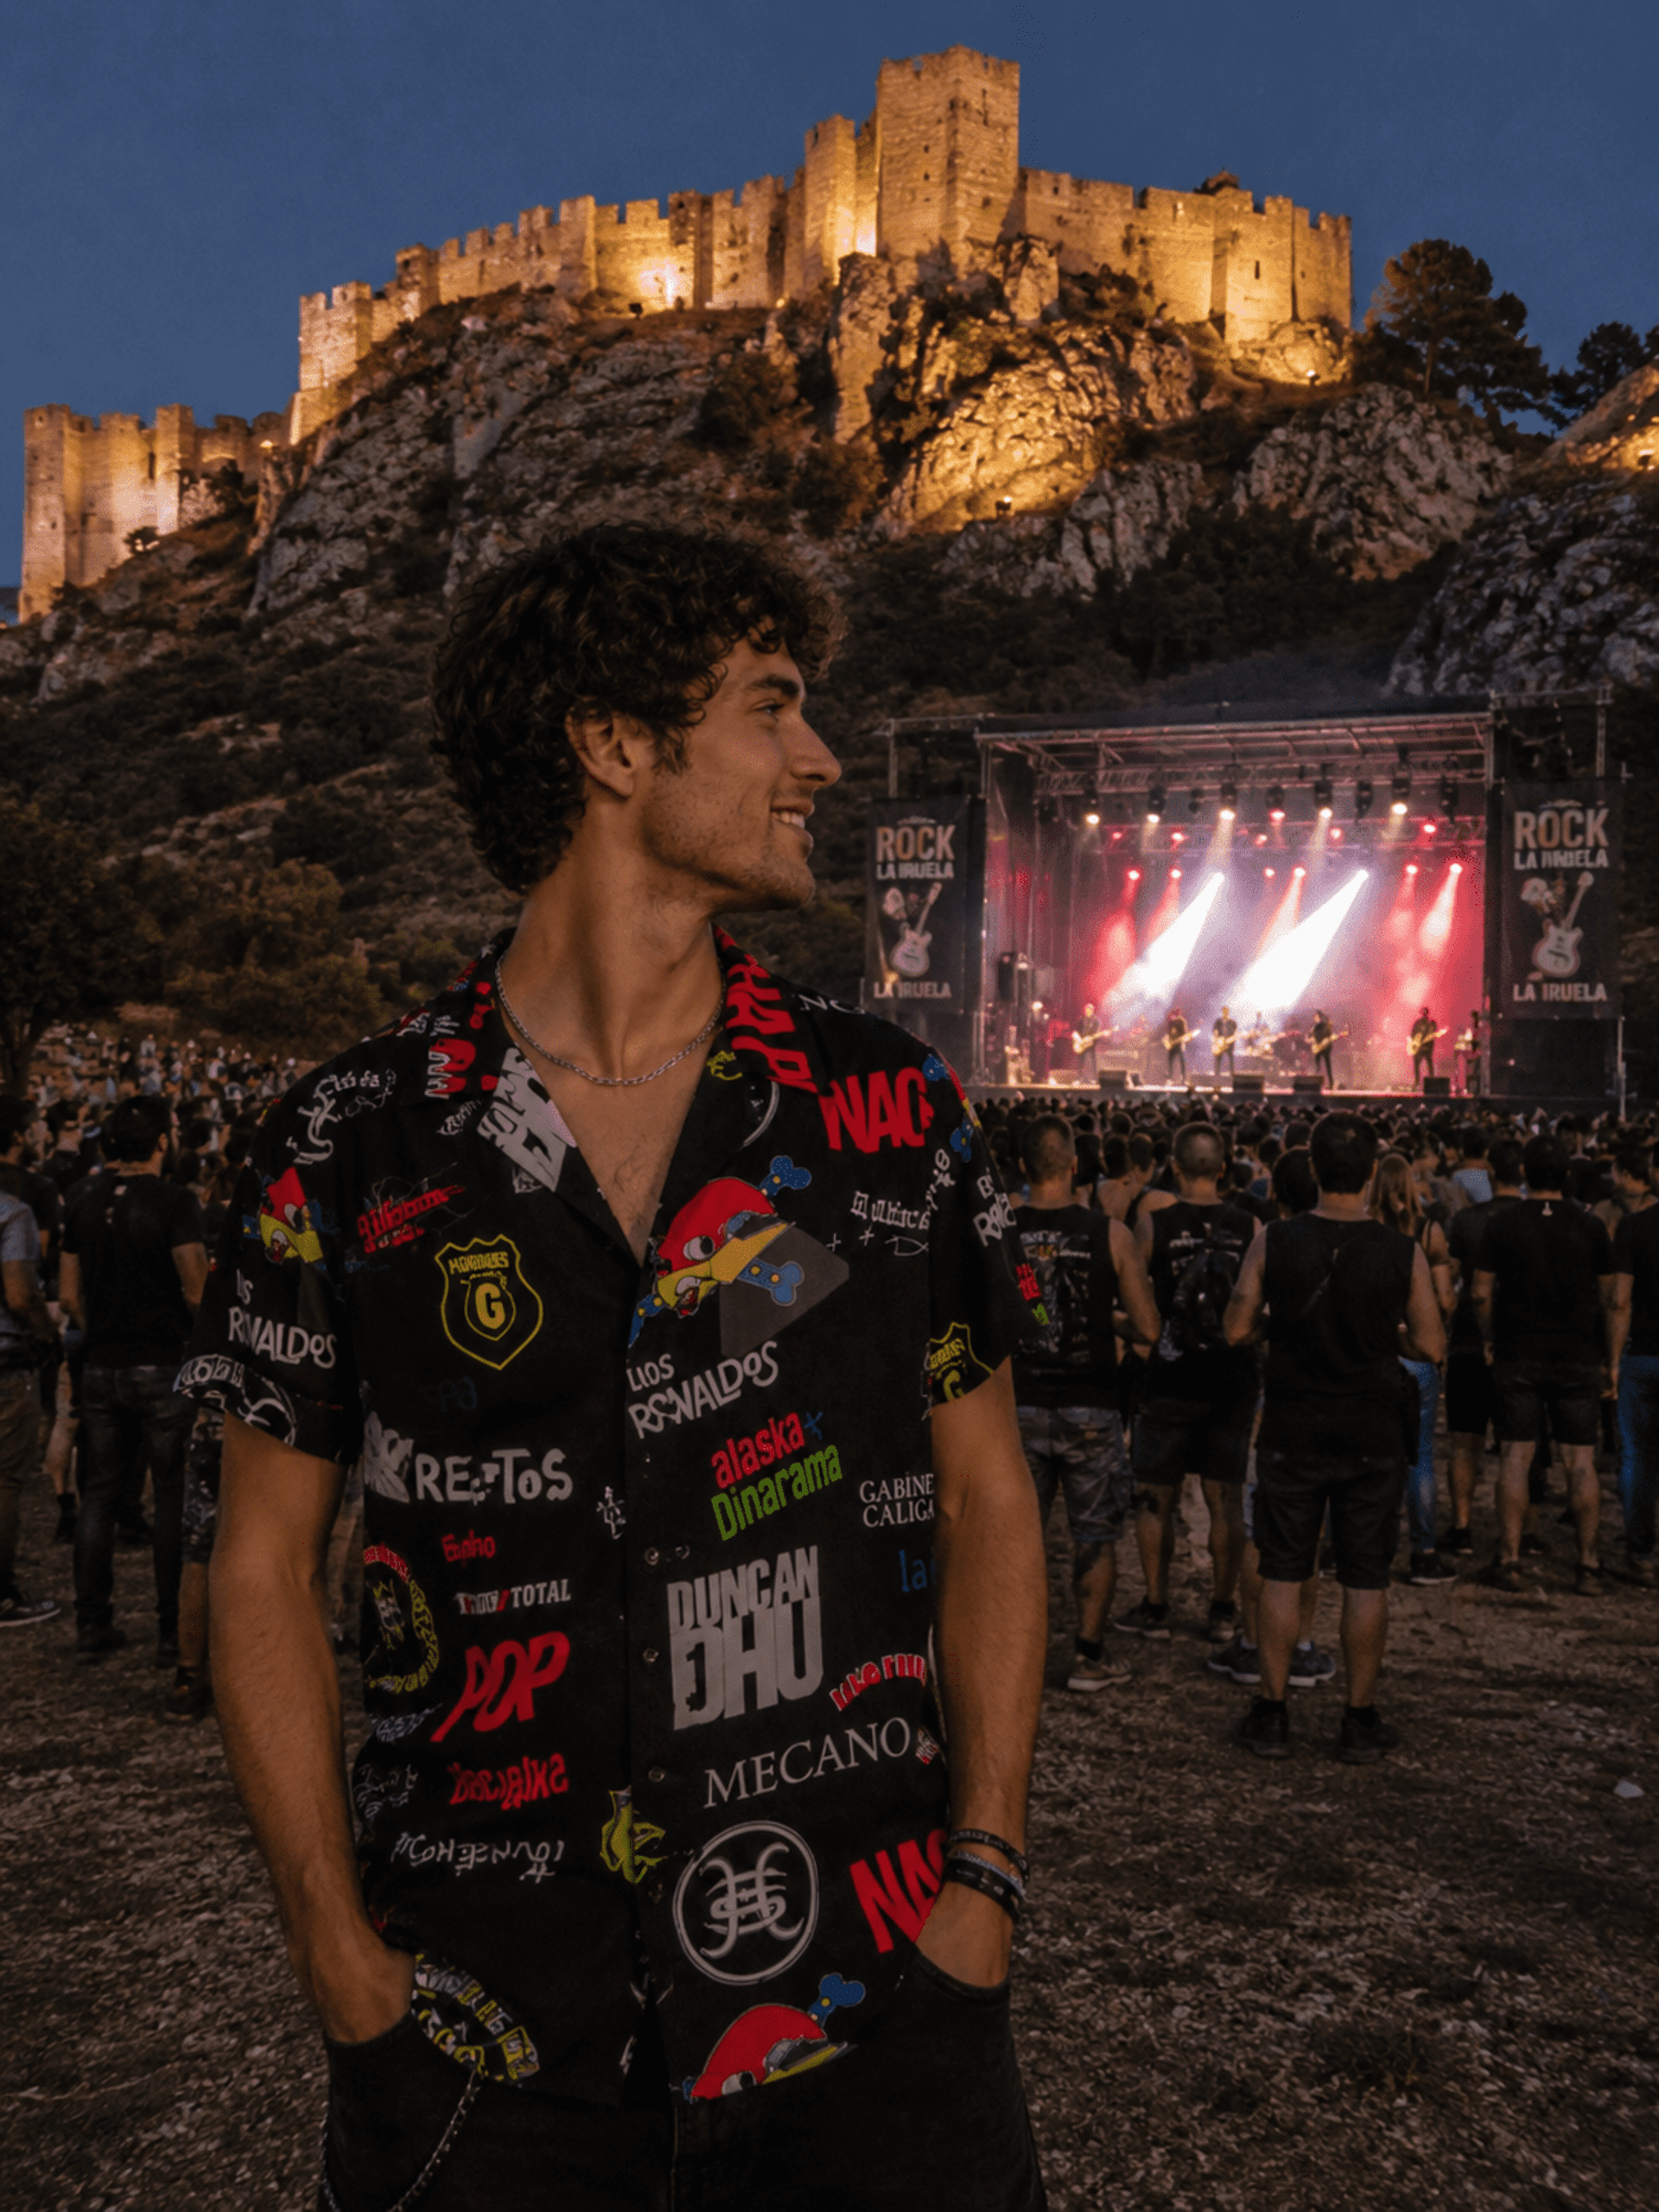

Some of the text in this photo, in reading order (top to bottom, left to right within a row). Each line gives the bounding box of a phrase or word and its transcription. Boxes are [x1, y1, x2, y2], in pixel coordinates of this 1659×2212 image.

[875, 823, 957, 862] ROCK
[1514, 807, 1611, 850] ROCK
[876, 863, 896, 880] LA
[1514, 850, 1538, 870] LA
[1513, 982, 1537, 1002] LA
[475, 1282, 506, 1330] G
[709, 1410, 806, 1491] alaska
[710, 1444, 843, 1541] Dinarama
[511, 1578, 571, 1608] TOTAL
[666, 1544, 819, 1630] DUNCAN
[429, 1630, 571, 1744] POP
[670, 1600, 824, 1732] DHU
[702, 1716, 912, 1809] MECANO
